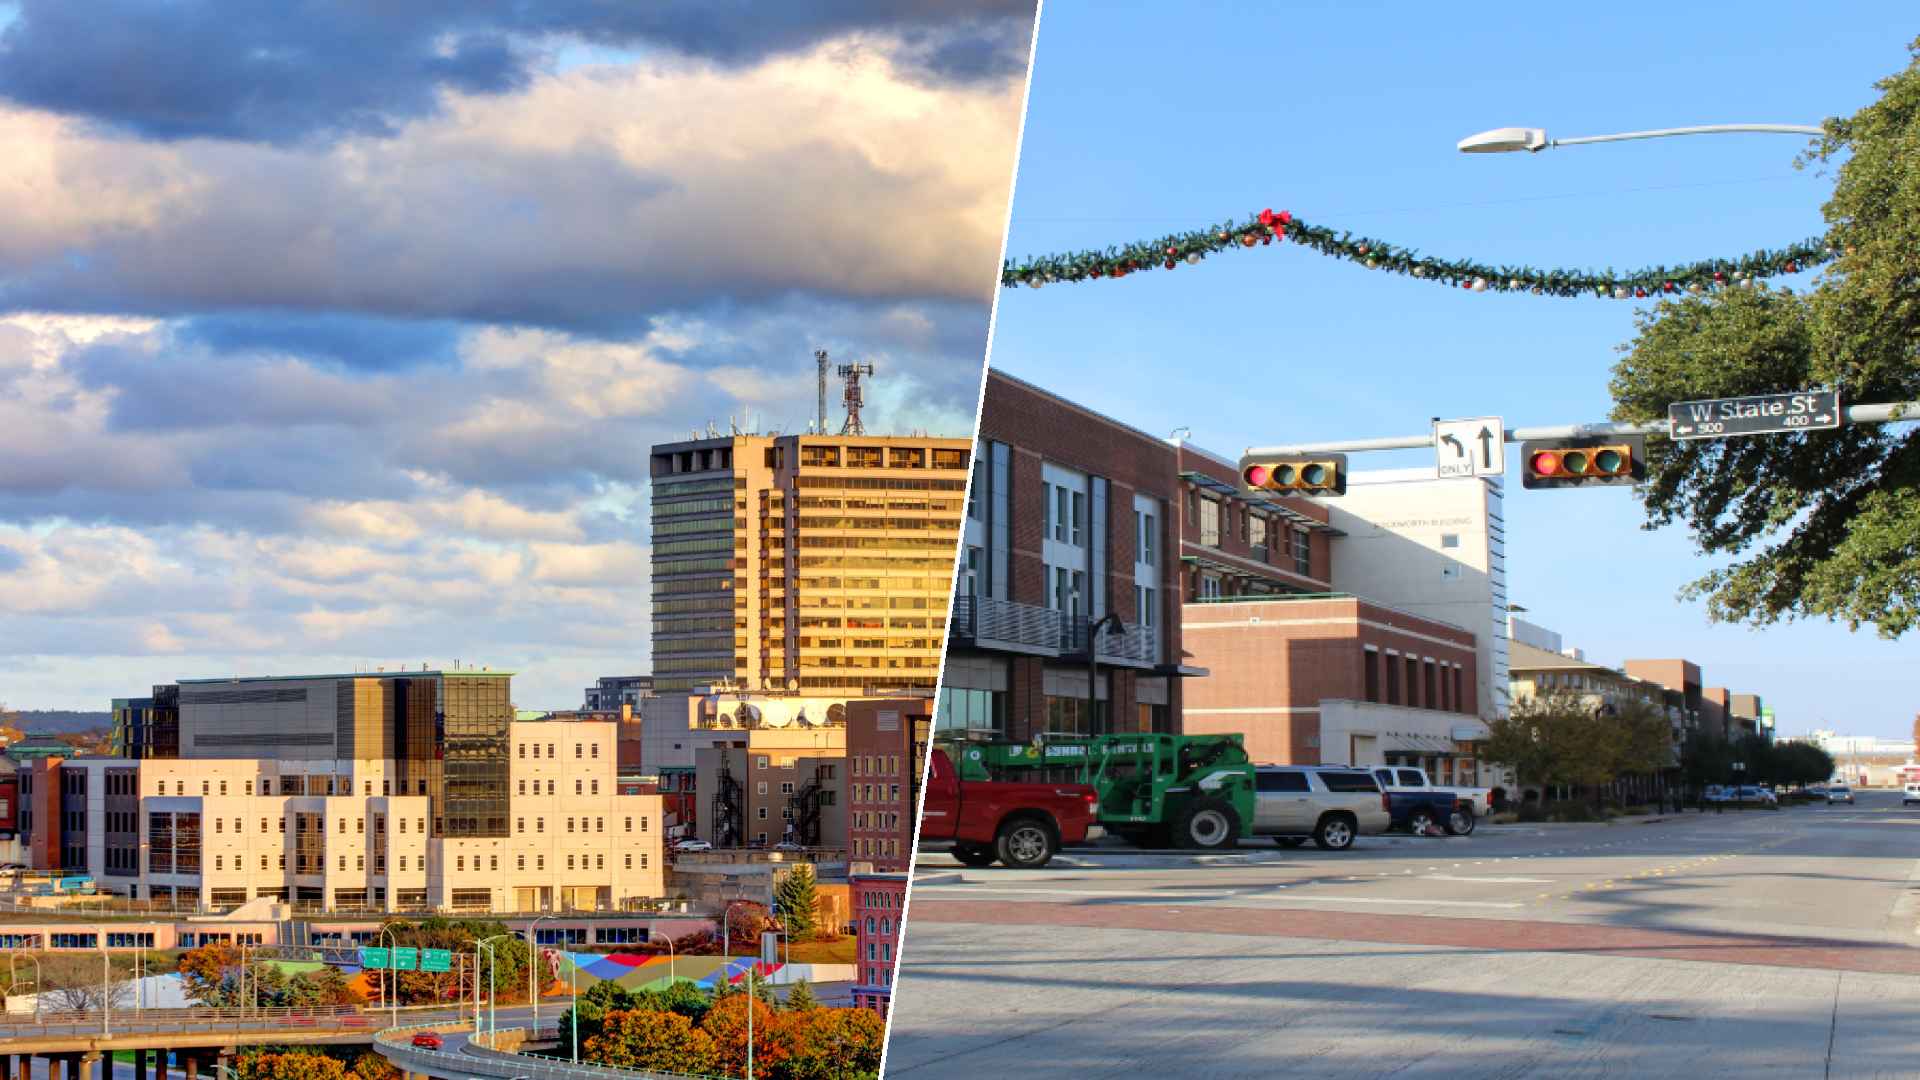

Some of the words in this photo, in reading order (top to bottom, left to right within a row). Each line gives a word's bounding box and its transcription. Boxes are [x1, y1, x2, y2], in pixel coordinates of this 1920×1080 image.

[1690, 403, 1712, 422] W
[1791, 395, 1816, 414] St
[1783, 415, 1809, 427] 400
[1697, 422, 1723, 434] 500
[1440, 463, 1472, 475] ONLY
